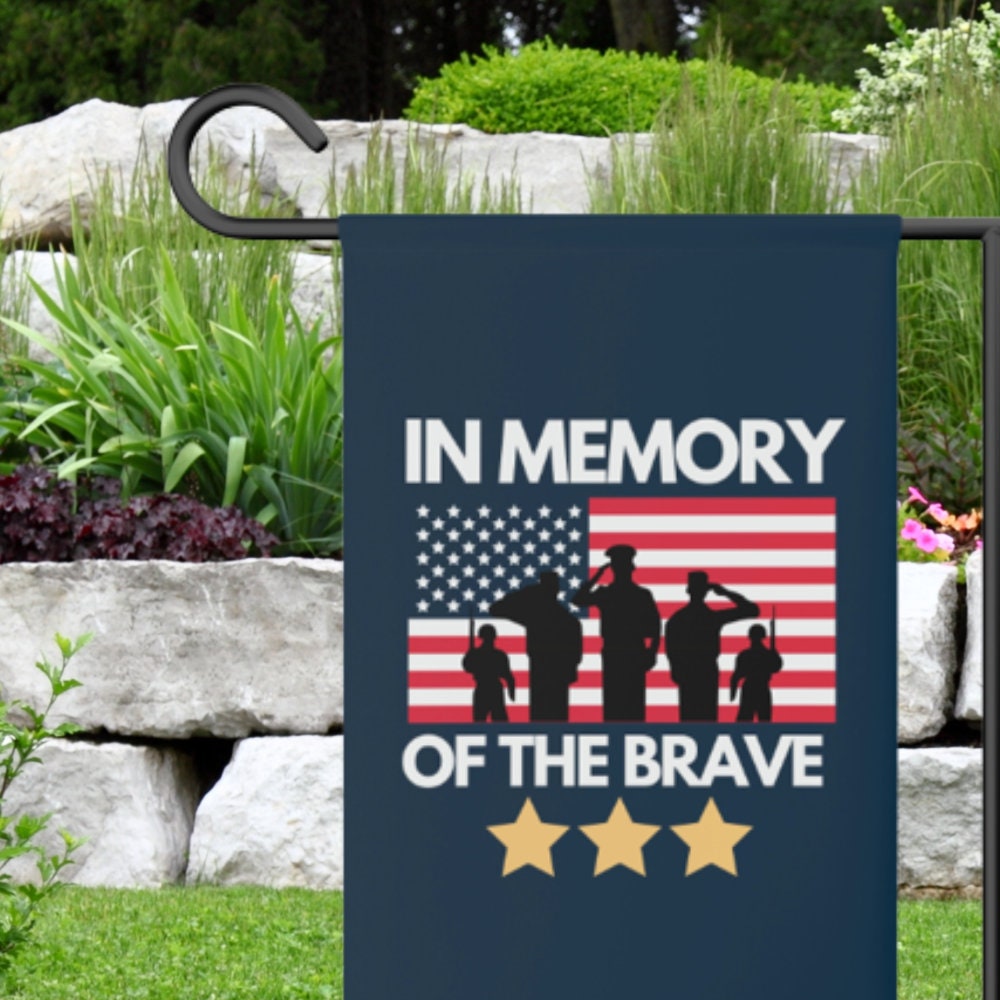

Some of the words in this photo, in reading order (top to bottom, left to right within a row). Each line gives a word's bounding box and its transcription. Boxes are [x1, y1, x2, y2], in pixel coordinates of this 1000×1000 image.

[405, 418, 482, 484] IN
[498, 418, 845, 485] MEMORY
[401, 733, 488, 788] OF
[498, 734, 609, 788] THE
[624, 734, 823, 788] BRAVE
